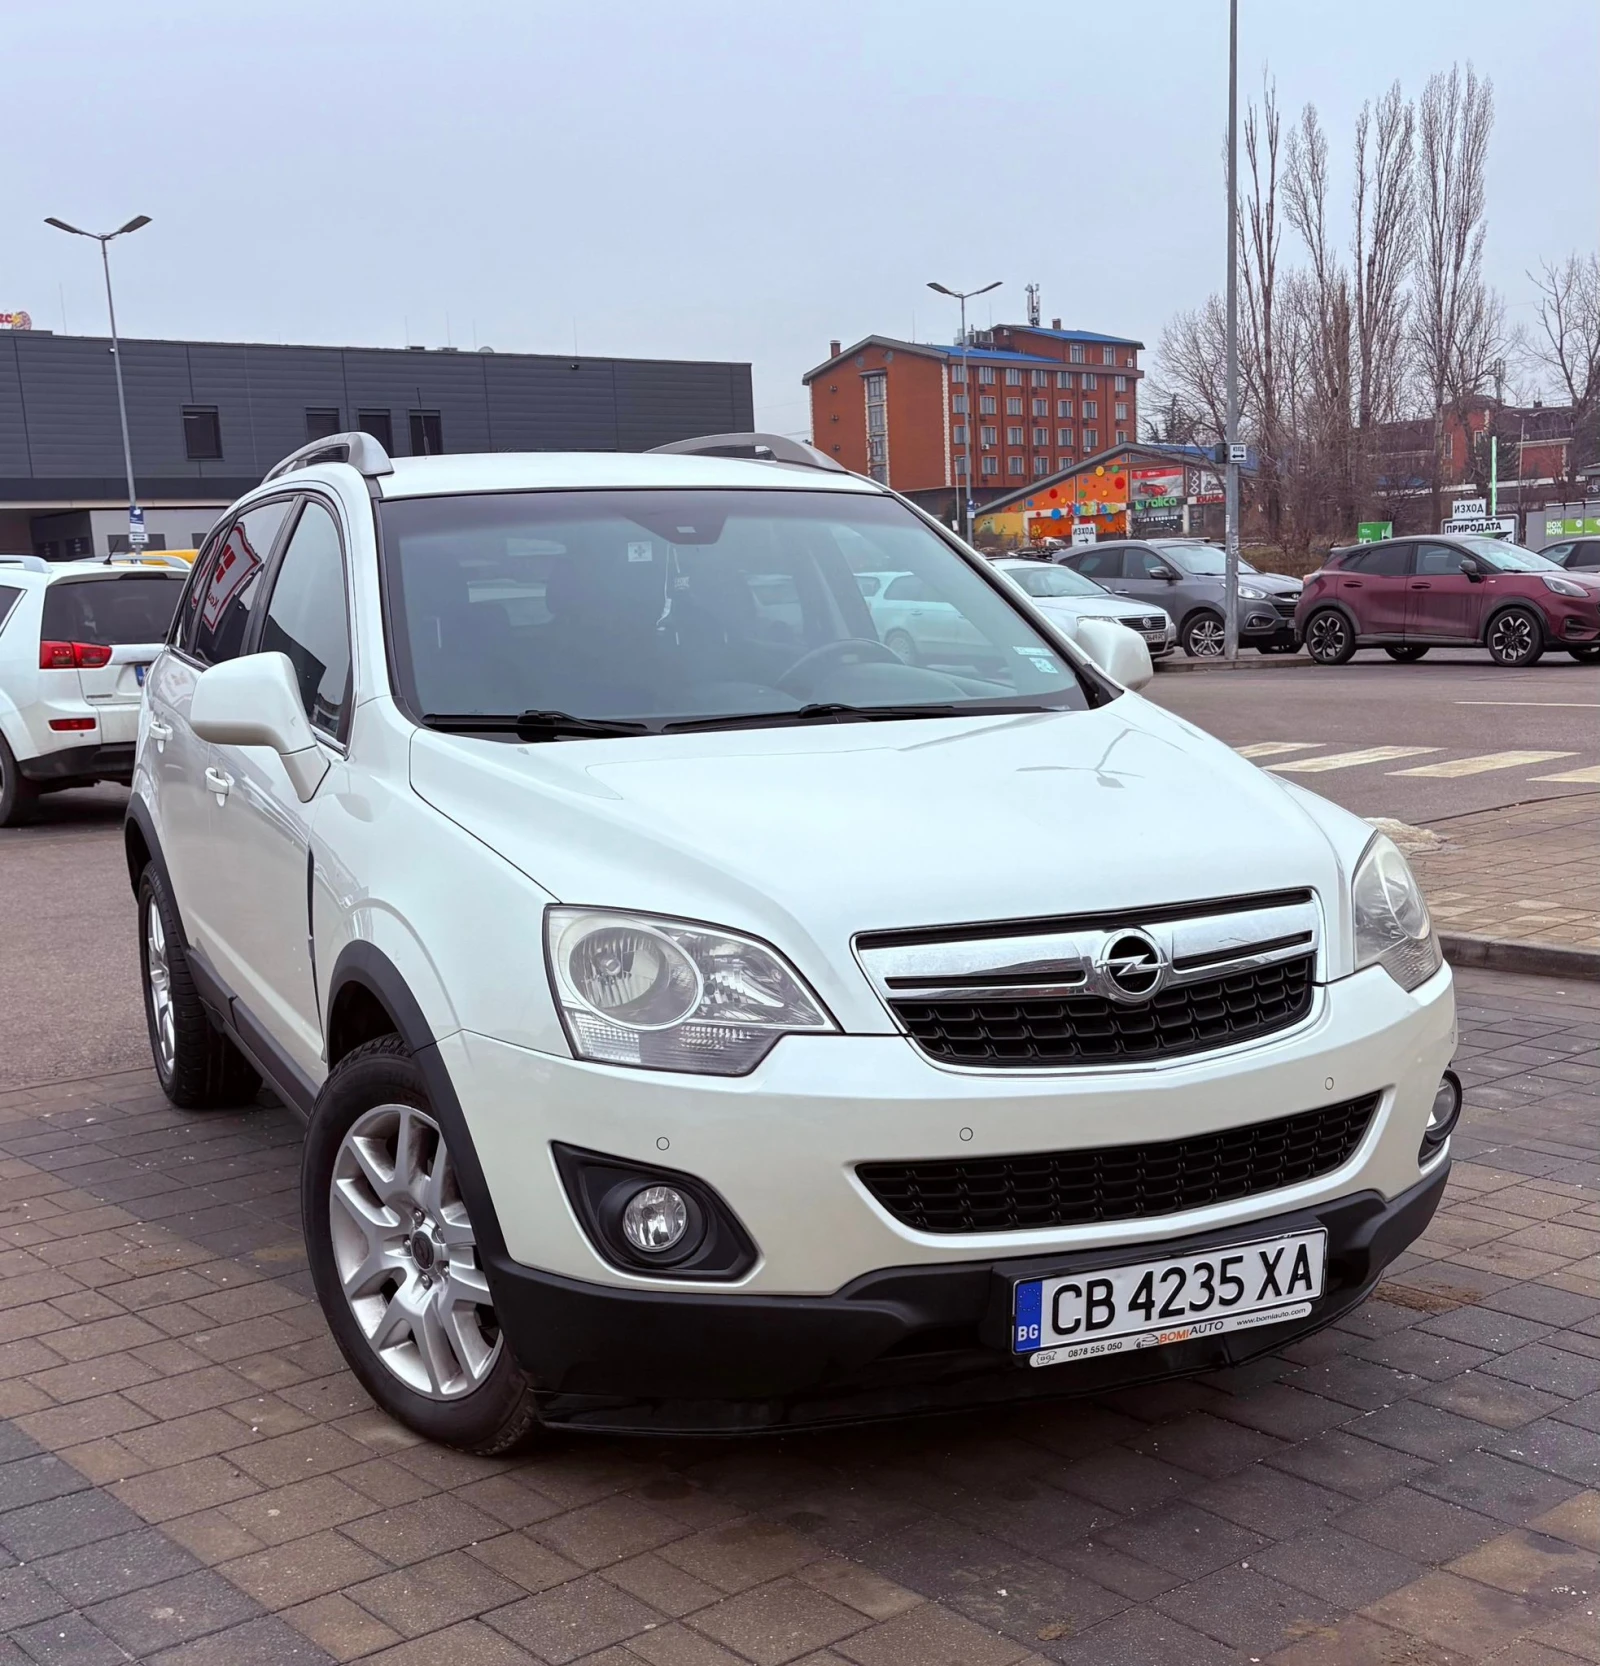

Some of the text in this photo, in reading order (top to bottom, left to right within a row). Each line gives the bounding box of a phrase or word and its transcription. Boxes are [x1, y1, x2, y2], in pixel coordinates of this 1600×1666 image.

[1454, 503, 1484, 513] ИЗХОД
[1073, 527, 1095, 535] ИЗХОД
[1446, 521, 1502, 533] ПРИРОДАТА
[1051, 1243, 1313, 1335] CB 4235 XA
[1236, 1307, 1306, 1327] www.bomiauto.com
[1017, 1324, 1039, 1342] BG
[1159, 1321, 1224, 1343] BOMIAUTO
[1068, 1342, 1123, 1358] 0878 555 050
